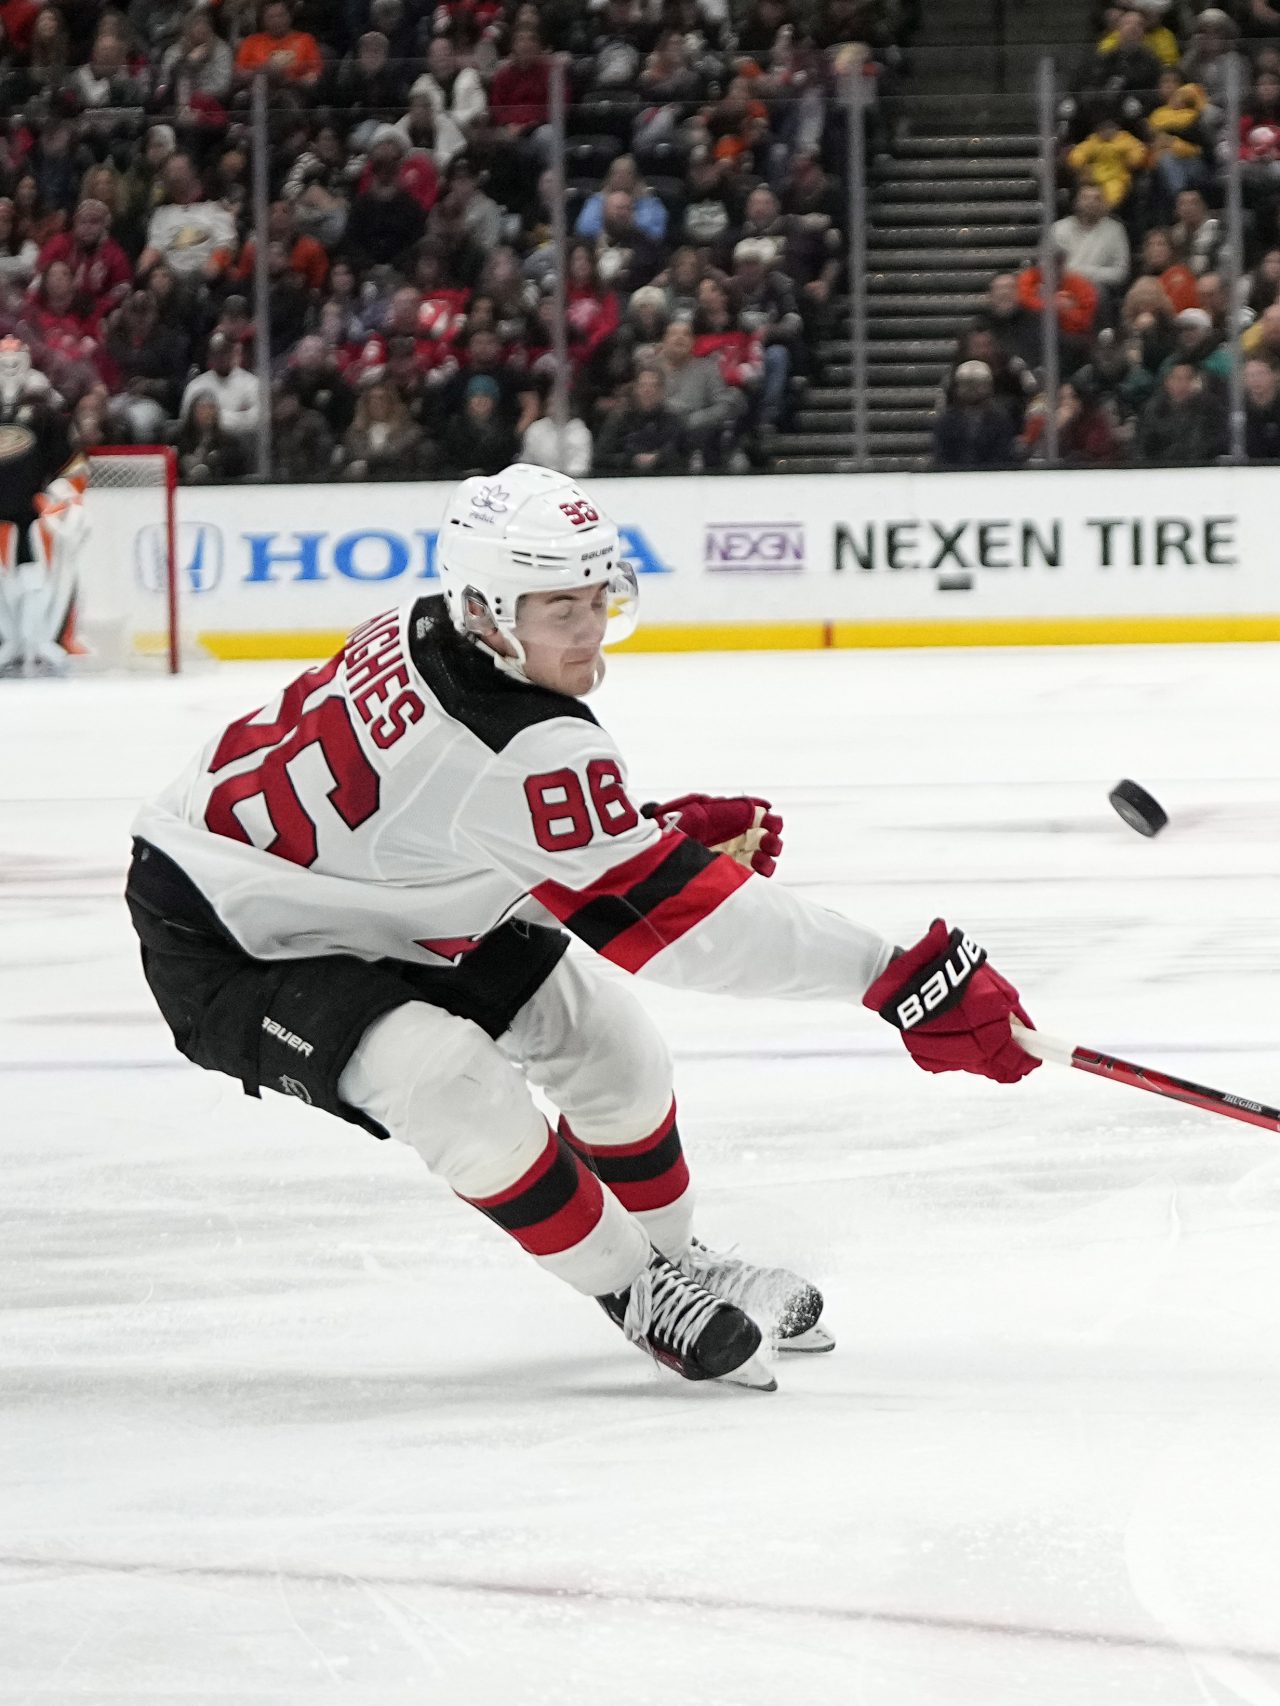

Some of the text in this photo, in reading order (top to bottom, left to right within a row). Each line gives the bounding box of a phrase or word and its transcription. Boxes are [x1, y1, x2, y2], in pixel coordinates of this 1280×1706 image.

[242, 527, 674, 583] HOA
[834, 520, 1063, 571] NEXEN
[1087, 513, 1237, 566] TIRE
[345, 606, 425, 749] UGHES
[523, 758, 639, 853] 86
[897, 933, 981, 1030] BAUE
